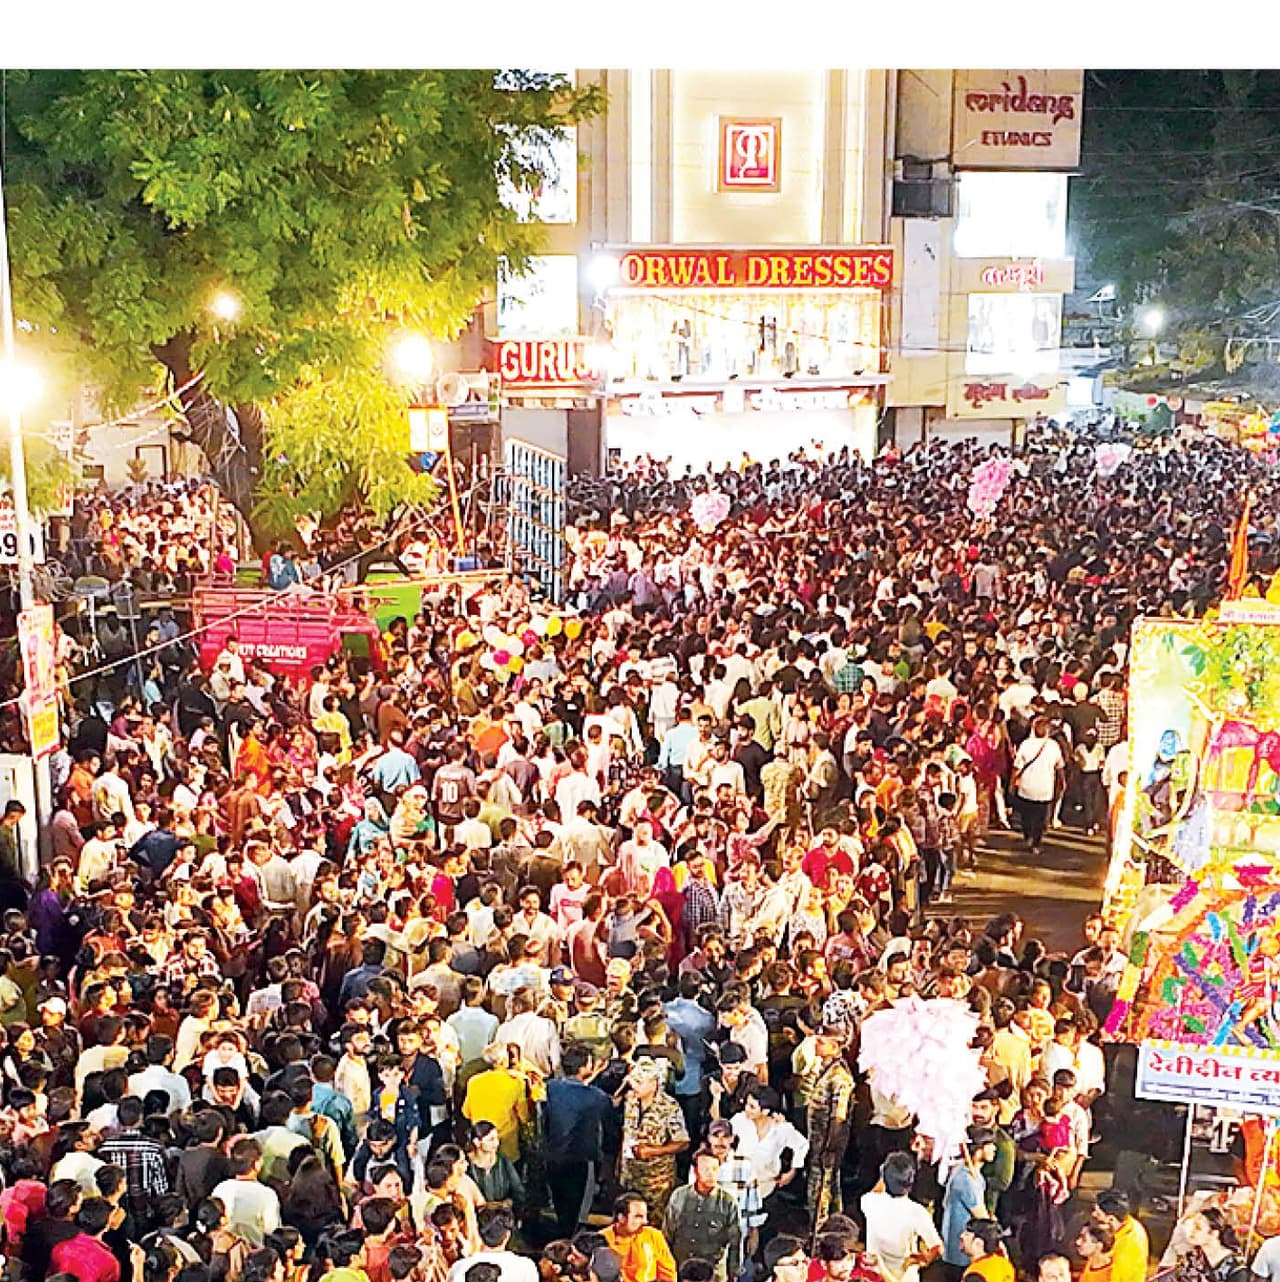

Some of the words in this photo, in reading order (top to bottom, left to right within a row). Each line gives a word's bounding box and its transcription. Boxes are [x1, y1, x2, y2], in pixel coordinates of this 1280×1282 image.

[621, 254, 735, 285] ORWAL
[747, 254, 892, 286] DRESSES
[1149, 1051, 1243, 1080] देवीदीन
